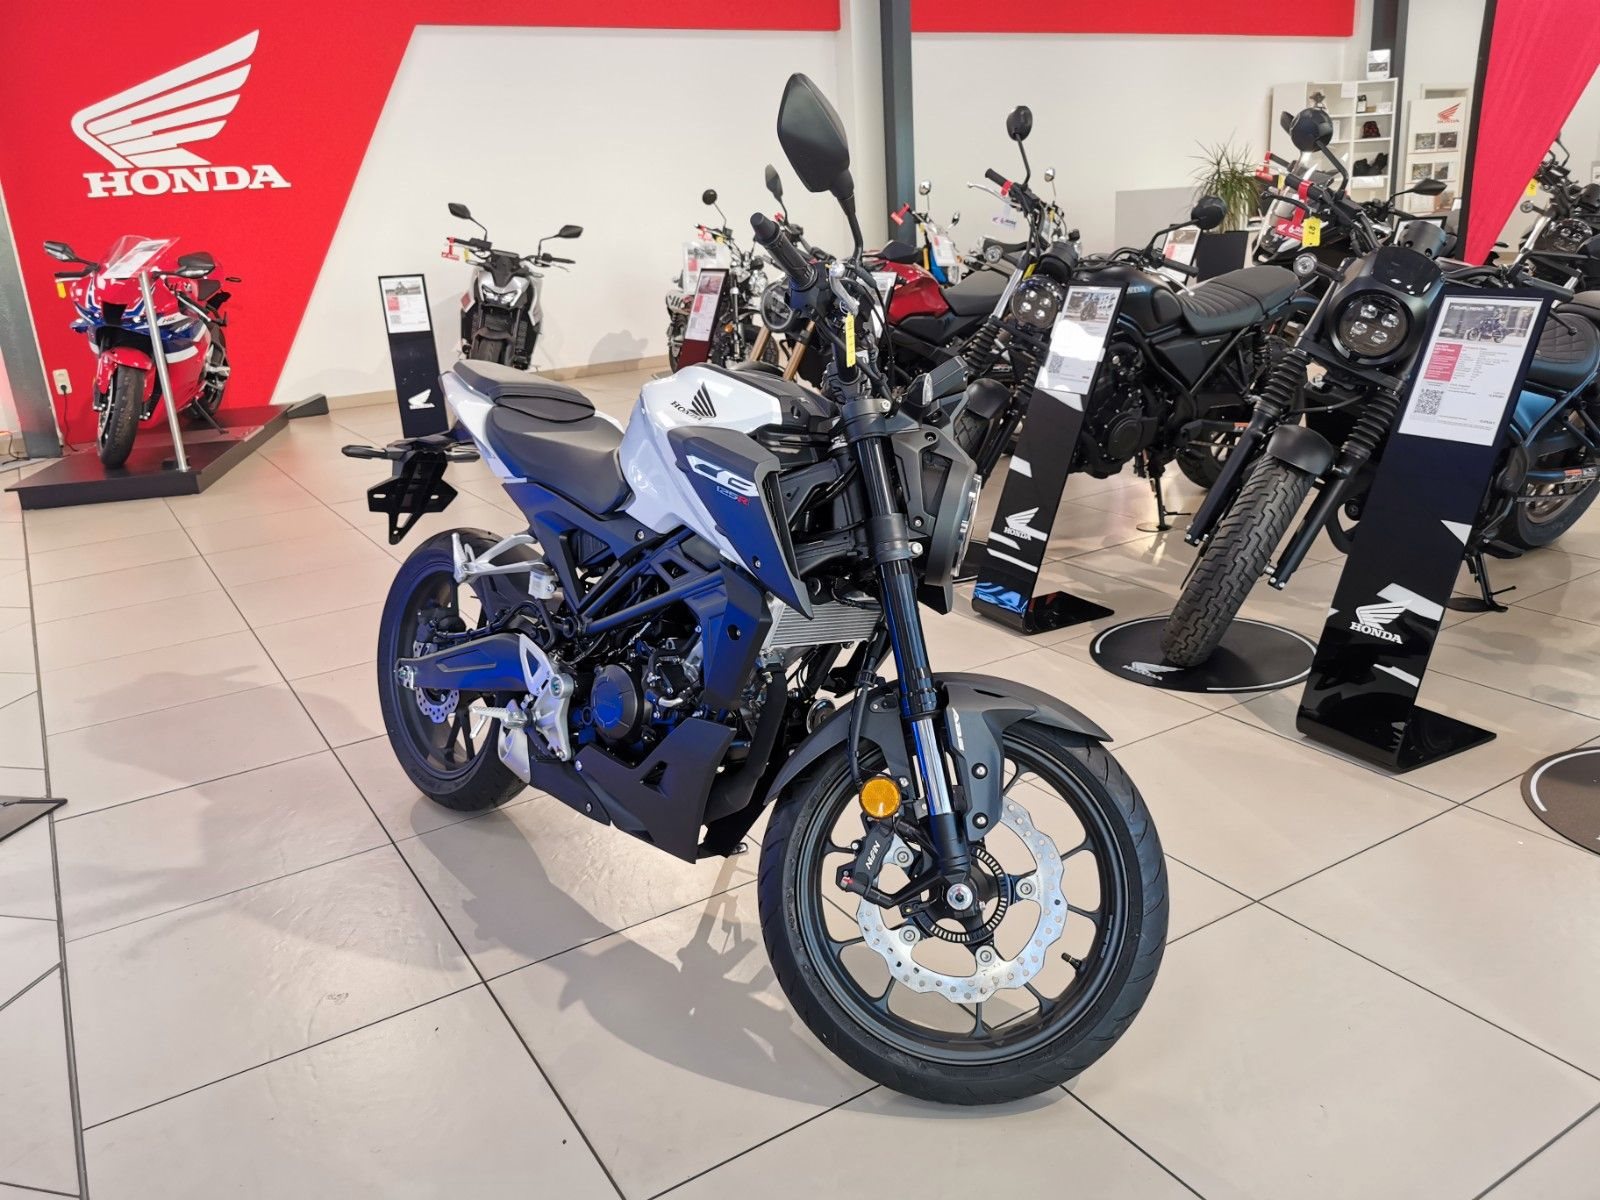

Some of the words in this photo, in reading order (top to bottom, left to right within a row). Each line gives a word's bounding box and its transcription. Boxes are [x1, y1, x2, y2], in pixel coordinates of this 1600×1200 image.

[83, 164, 292, 198] HONDA
[685, 454, 760, 497] CB
[716, 485, 750, 507] 125R
[1003, 526, 1032, 541] HONDA
[1349, 621, 1404, 645] HONDA
